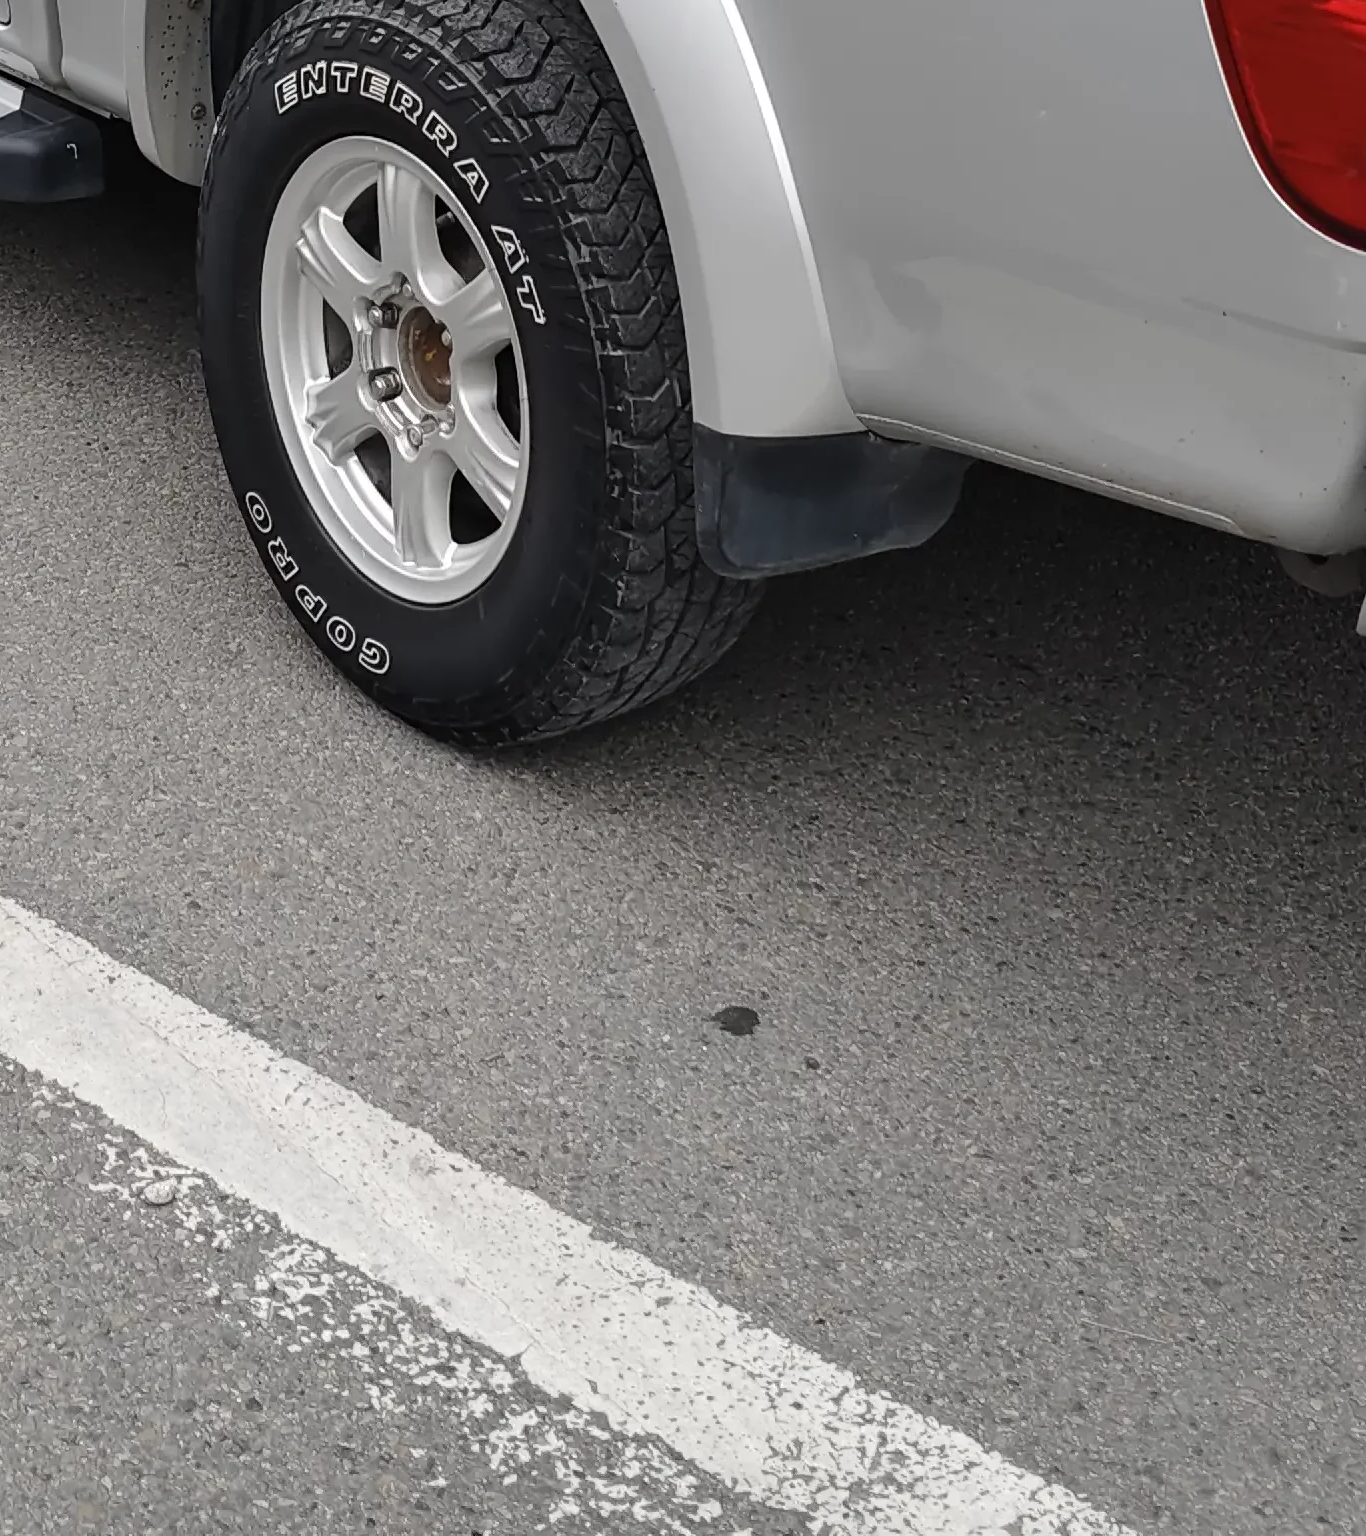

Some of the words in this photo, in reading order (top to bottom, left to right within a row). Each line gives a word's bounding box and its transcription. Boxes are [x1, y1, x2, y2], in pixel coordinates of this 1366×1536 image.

[274, 60, 491, 205] ENTERRA
[490, 224, 546, 325] AT
[245, 491, 391, 675] GOPRO
